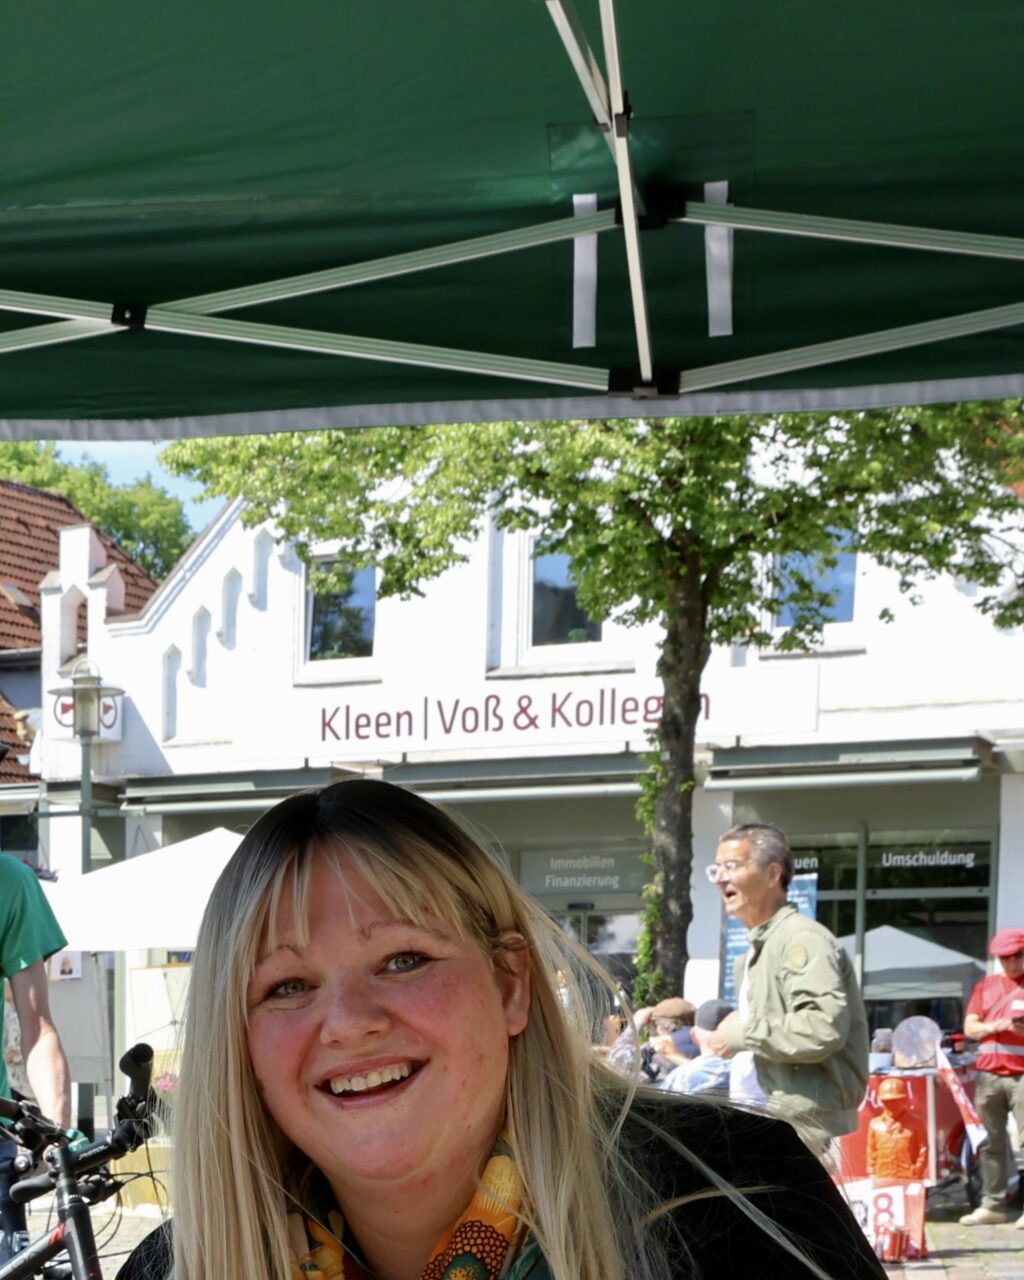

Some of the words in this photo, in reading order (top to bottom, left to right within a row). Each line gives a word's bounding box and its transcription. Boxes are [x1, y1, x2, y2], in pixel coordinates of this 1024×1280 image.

[322, 704, 413, 741] Kleen
[437, 695, 504, 734] Voß
[513, 695, 540, 730] &
[551, 688, 710, 728] Kollegn
[550, 856, 615, 870] Immobilien
[794, 857, 818, 869] uen
[882, 850, 975, 868] Umschuldung
[545, 874, 620, 889] Finanzierung
